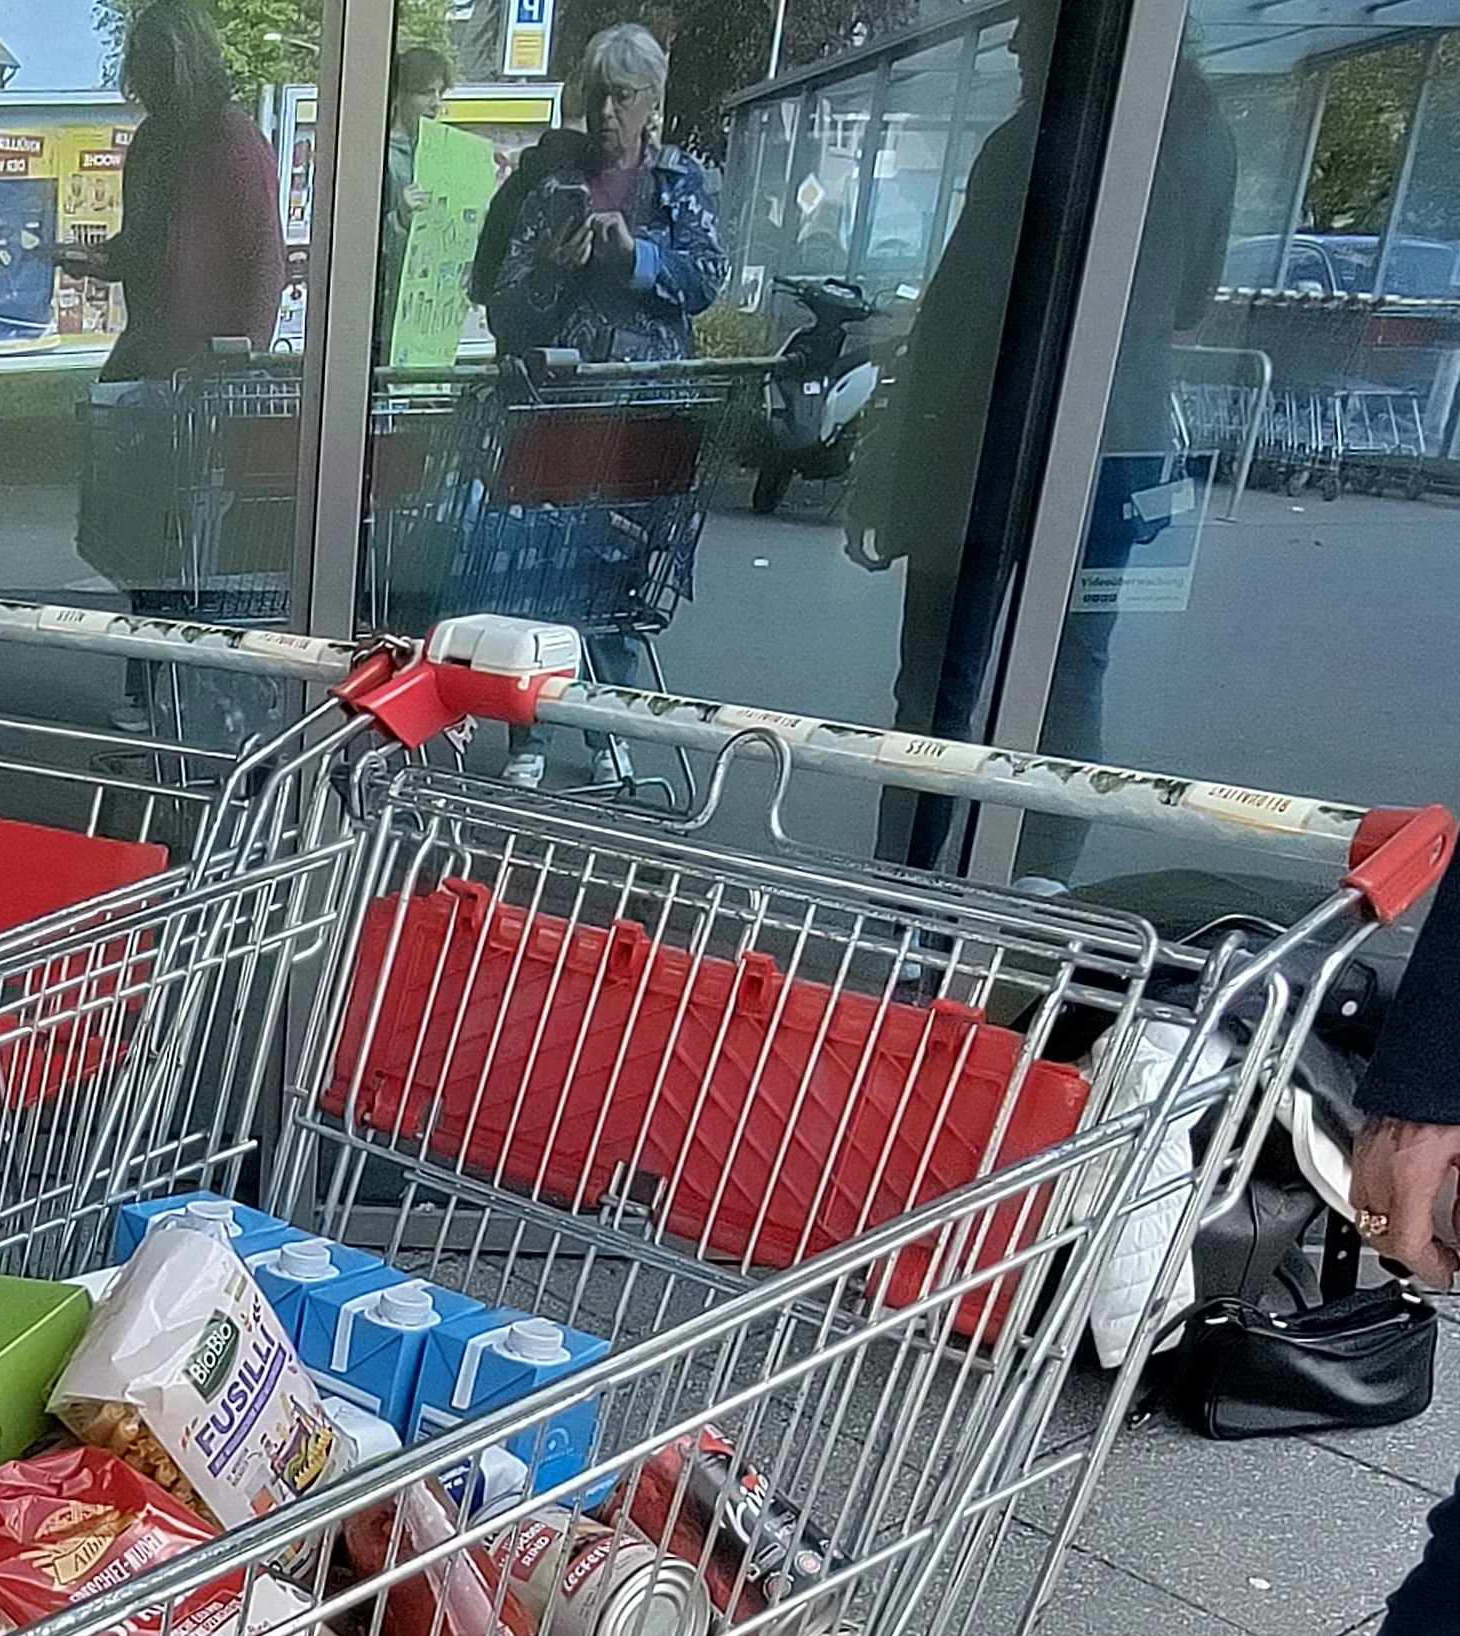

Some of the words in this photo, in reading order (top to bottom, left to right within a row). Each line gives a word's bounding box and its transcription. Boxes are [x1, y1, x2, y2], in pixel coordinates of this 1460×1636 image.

[189, 1320, 233, 1390] BioBio
[193, 1322, 277, 1459] FUSILLI
[520, 1535, 551, 1567] RIND
